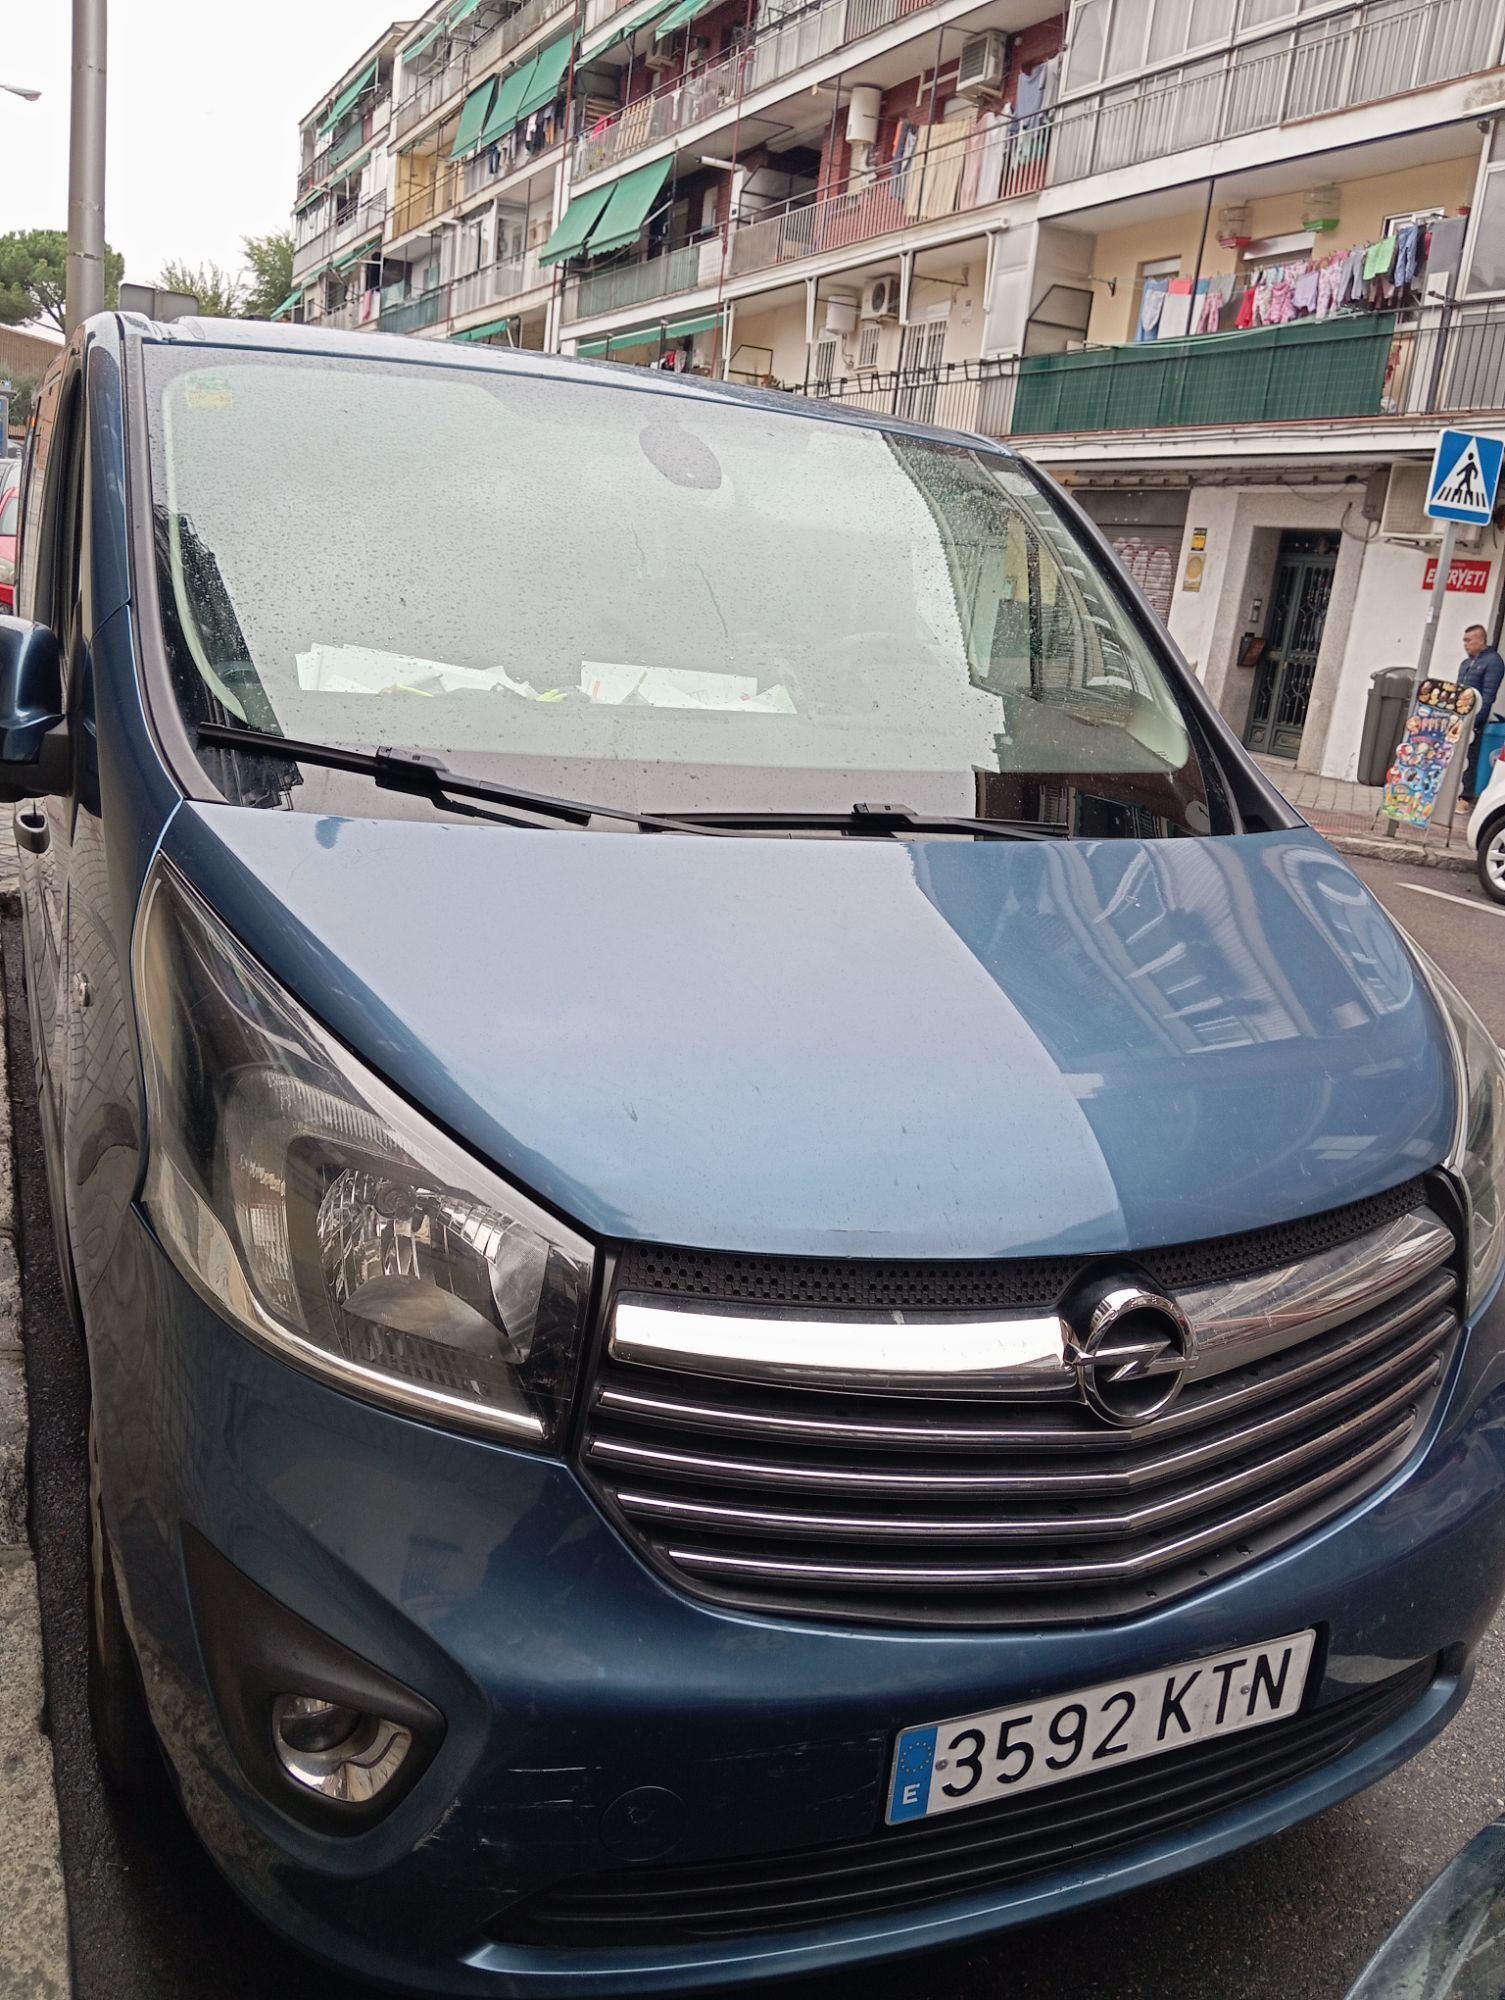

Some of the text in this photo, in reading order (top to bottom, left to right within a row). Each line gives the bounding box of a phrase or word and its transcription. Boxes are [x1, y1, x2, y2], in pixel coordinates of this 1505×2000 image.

[1425, 568, 1487, 589] ERYETI
[942, 1648, 1292, 1797] 3592 KTN
[902, 1783, 920, 1805] E
